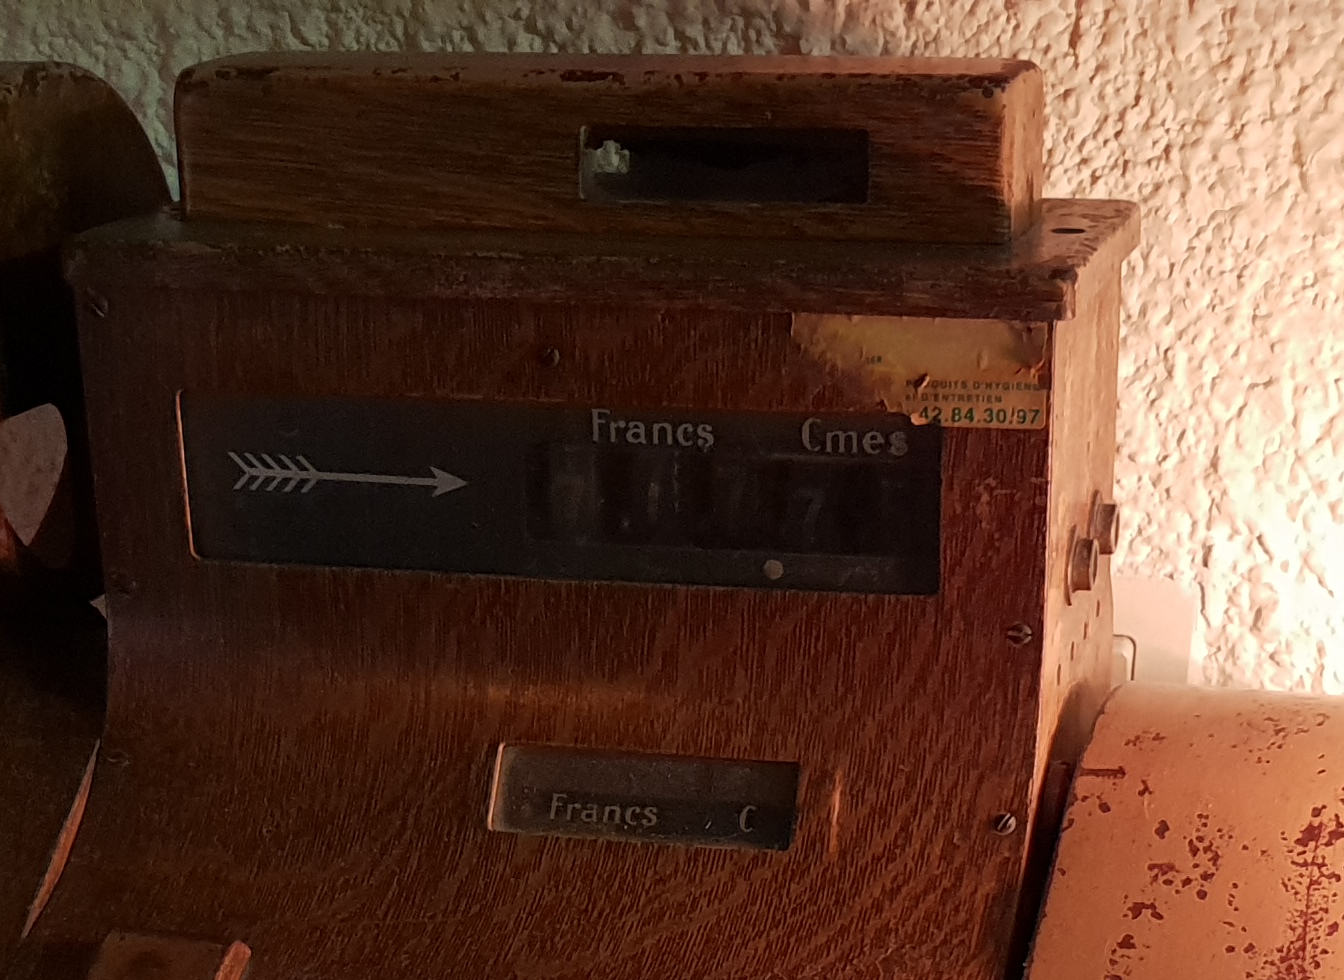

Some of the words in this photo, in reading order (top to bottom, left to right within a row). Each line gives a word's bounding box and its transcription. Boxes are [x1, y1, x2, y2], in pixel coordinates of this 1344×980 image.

[590, 408, 716, 448] Francs
[801, 417, 909, 456] Cmes
[549, 792, 658, 827] Francs
